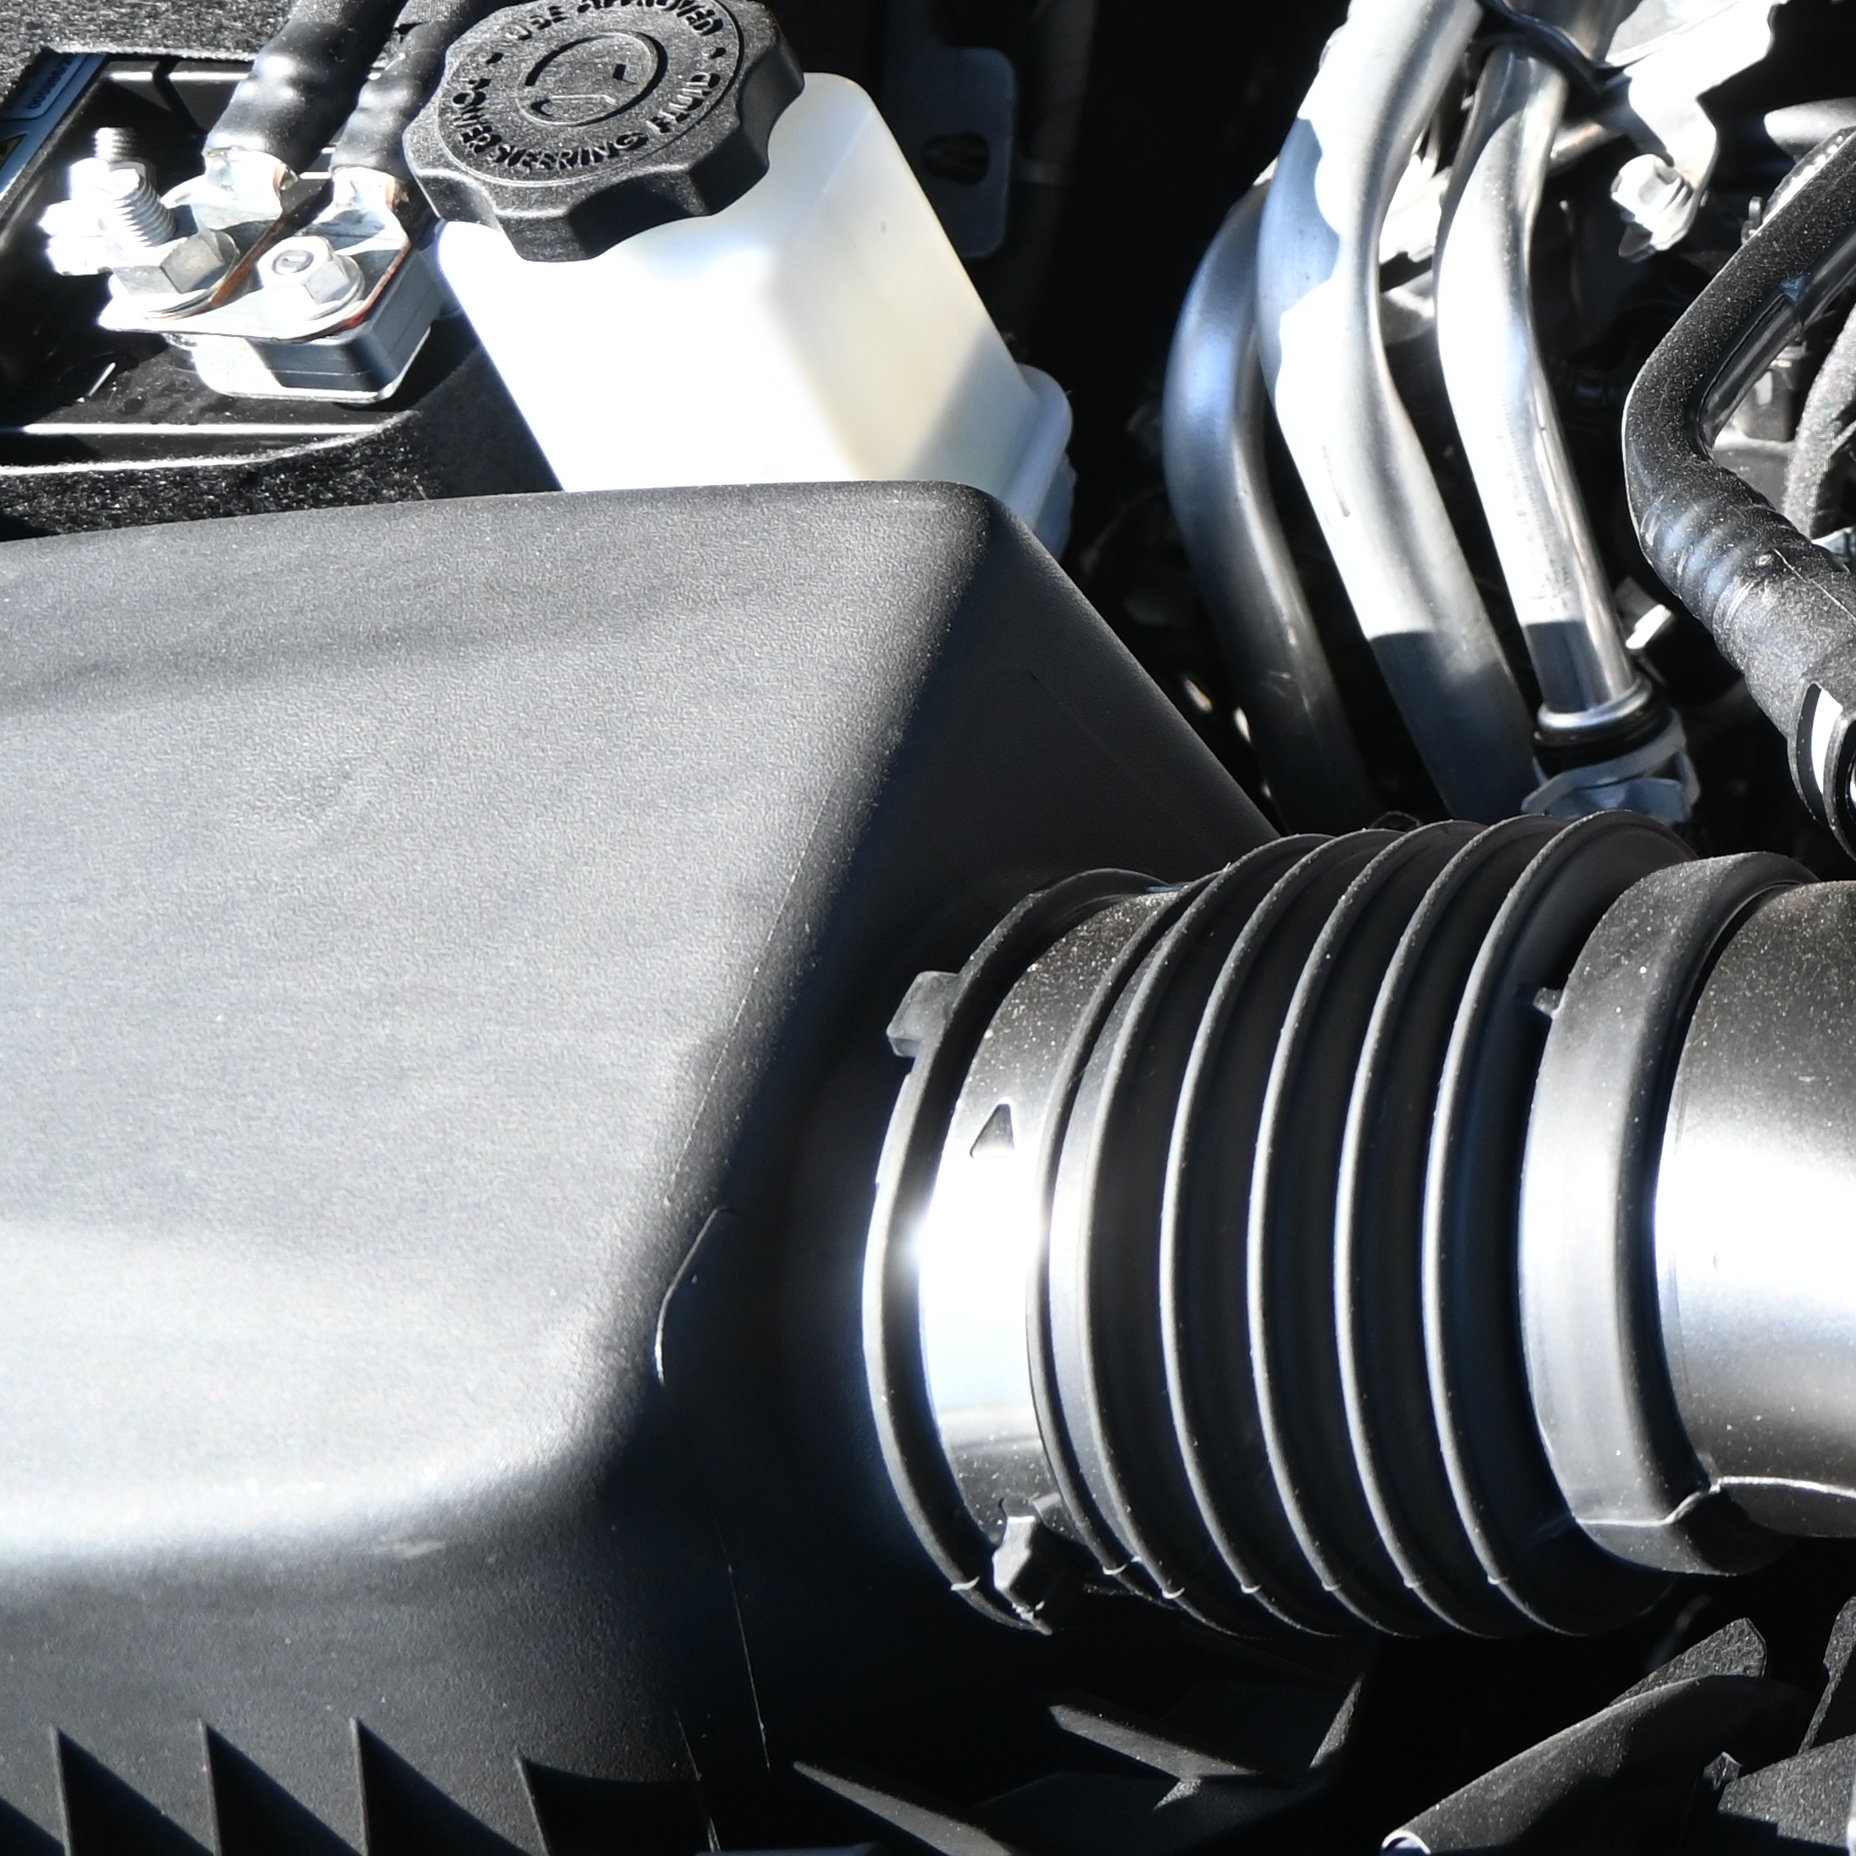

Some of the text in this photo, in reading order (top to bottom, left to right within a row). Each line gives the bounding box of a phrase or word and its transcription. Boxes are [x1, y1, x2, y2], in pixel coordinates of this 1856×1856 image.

[503, 4, 571, 41] USE
[451, 69, 722, 172] POWER STEERING FLUID
